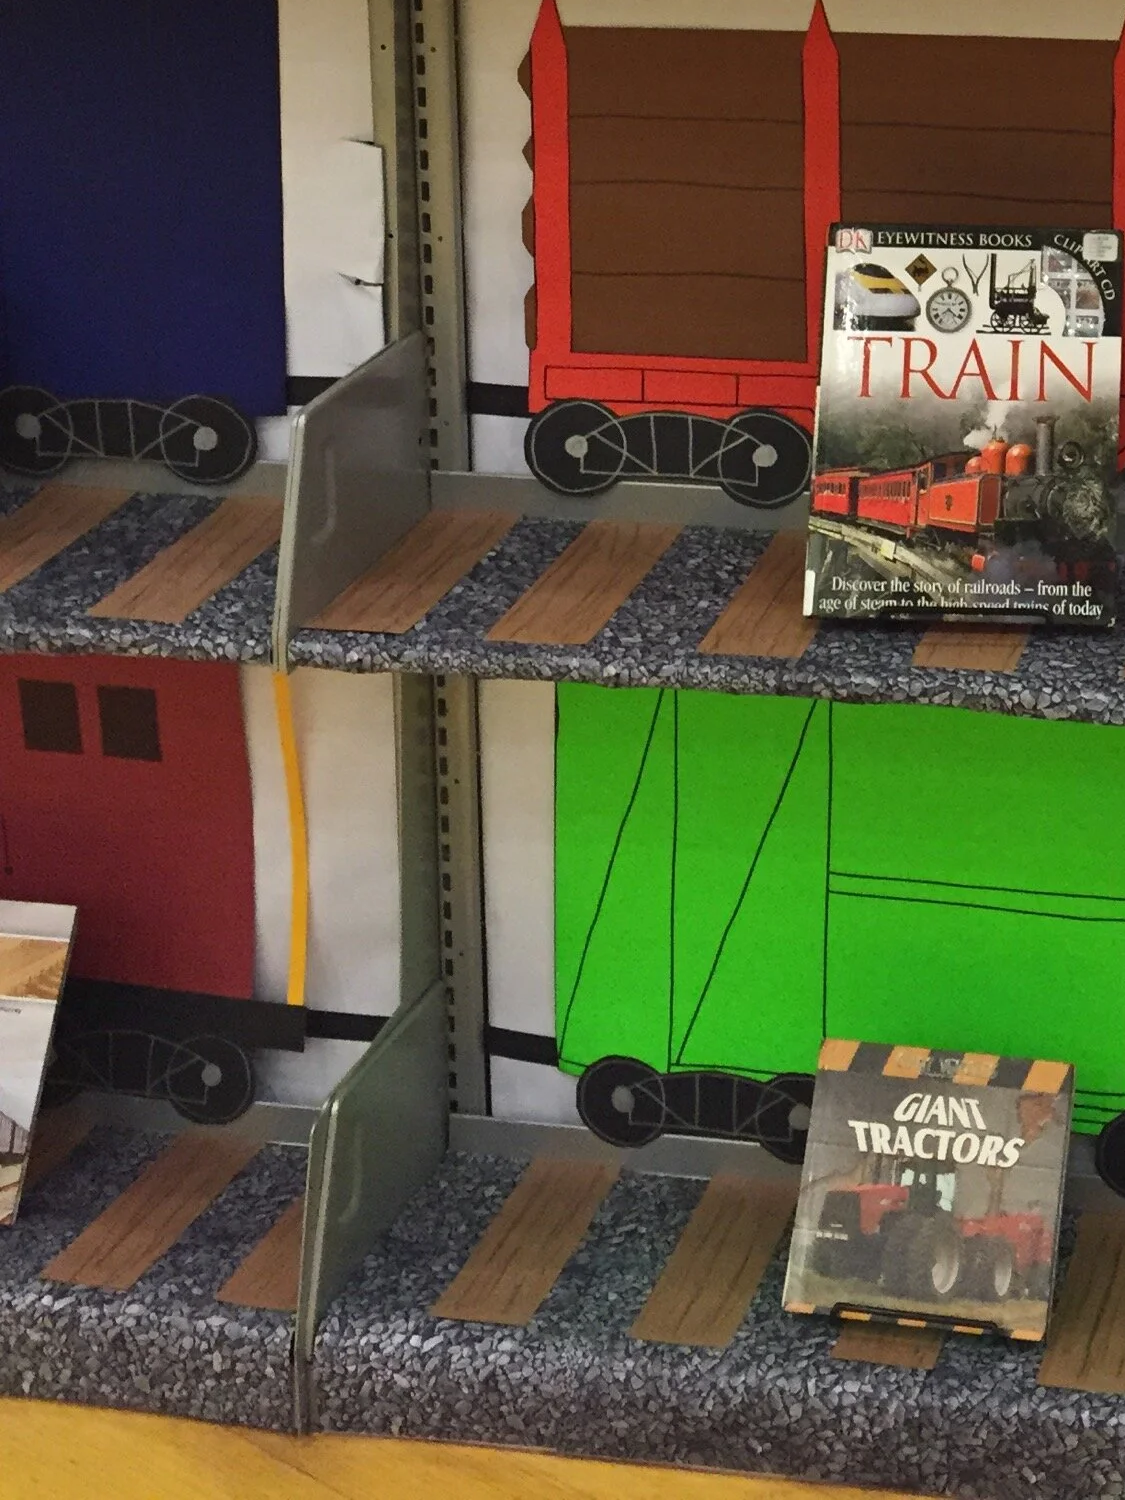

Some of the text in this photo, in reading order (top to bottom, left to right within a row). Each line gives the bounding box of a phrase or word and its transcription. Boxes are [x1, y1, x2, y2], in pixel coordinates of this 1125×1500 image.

[837, 229, 868, 250] DK
[877, 230, 1033, 247] EYEWITNESS BOOKS
[1100, 279, 1116, 300] CD
[847, 336, 1099, 403] TRAIN
[832, 576, 887, 592] Discover
[890, 577, 911, 593] the
[914, 579, 943, 596] story
[948, 579, 962, 594] of
[964, 579, 1021, 596] railroads
[1037, 580, 1068, 597] from
[1072, 581, 1092, 597] the
[819, 598, 841, 612] age
[844, 595, 858, 610] of
[861, 598, 897, 611] steam
[1052, 600, 1067, 615] of
[1069, 600, 1103, 620] today
[893, 1092, 987, 1131] GIANT
[847, 1119, 1025, 1168] TRACTORS
